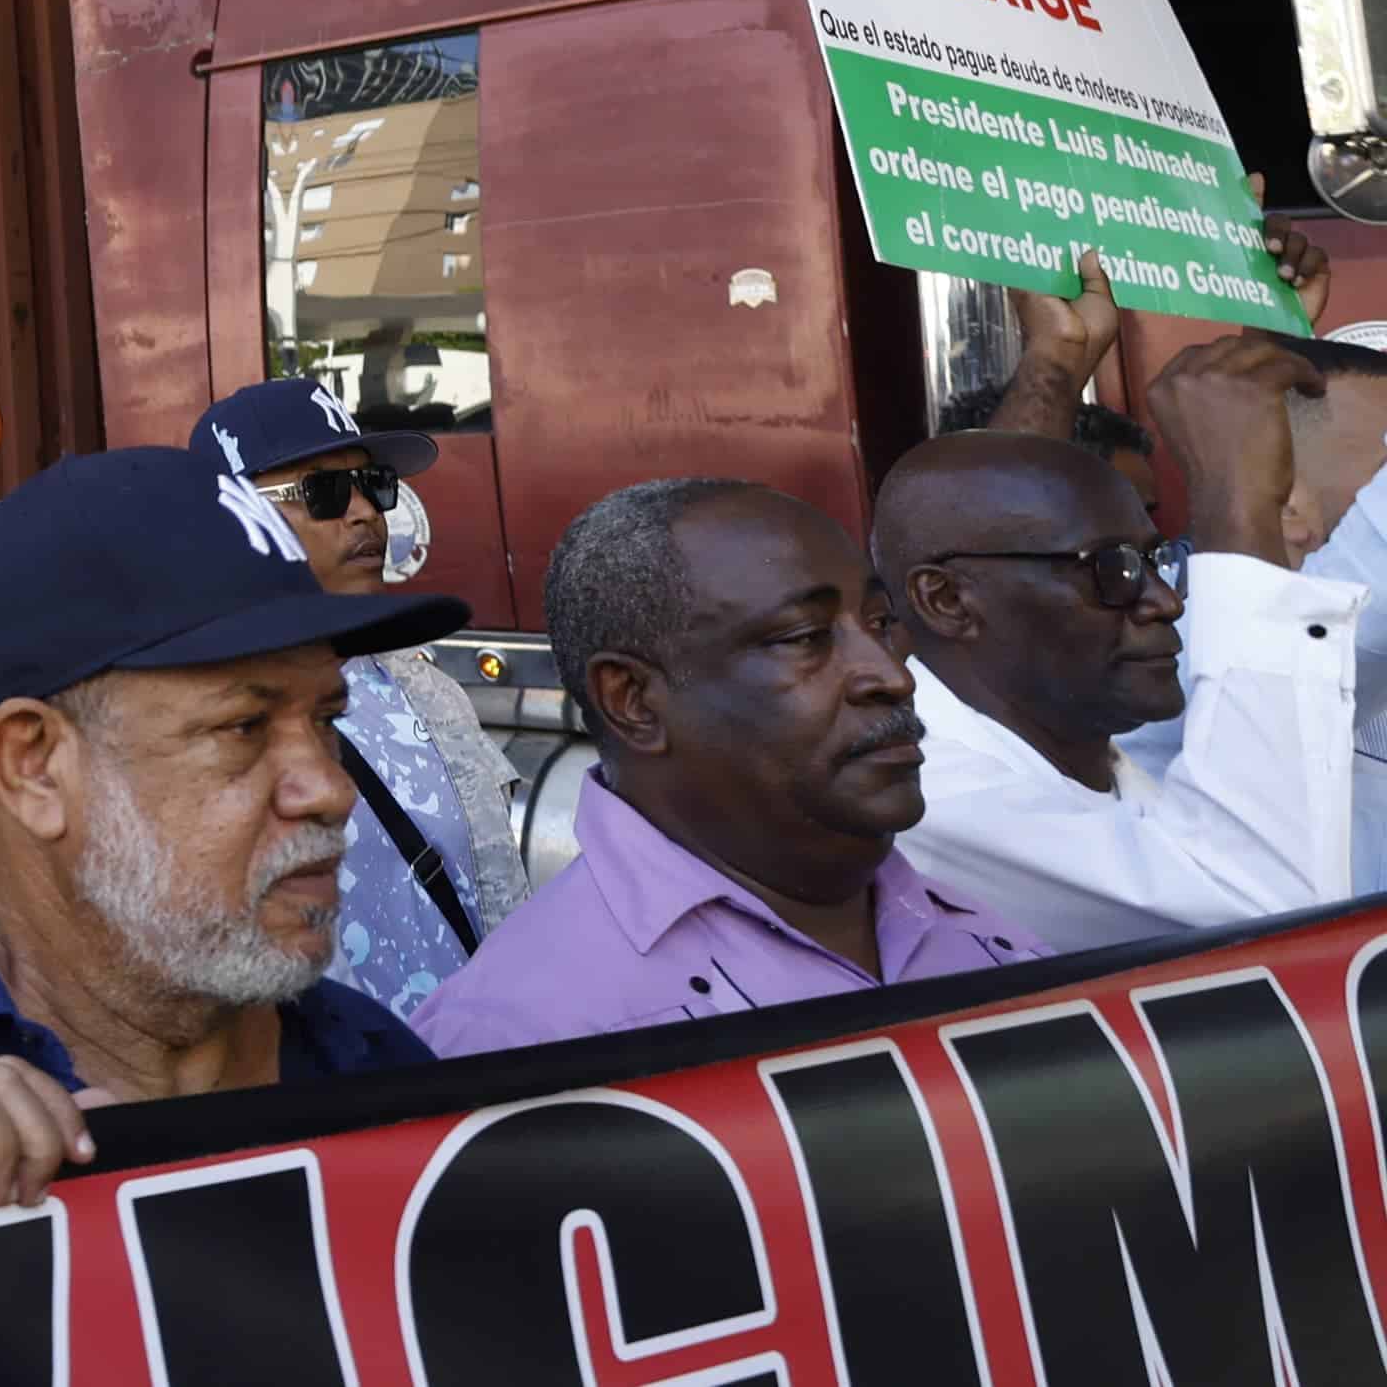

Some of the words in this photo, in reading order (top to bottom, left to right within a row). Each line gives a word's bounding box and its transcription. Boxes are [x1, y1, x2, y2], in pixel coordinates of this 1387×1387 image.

[820, 9, 859, 41] Que
[863, 19, 880, 46] el
[883, 29, 941, 62] estado
[946, 45, 997, 76] pague
[1001, 54, 1050, 87] deuda
[1053, 68, 1072, 92] de
[1076, 73, 1138, 109] choferes
[1139, 94, 1150, 118] y
[887, 81, 1045, 148] Presidente
[1049, 118, 1108, 161] Luis
[1113, 134, 1219, 188] Abinader
[869, 146, 974, 193] ordene
[982, 166, 1009, 199] el
[1016, 177, 1084, 220] pago
[1091, 192, 1220, 240] pendiente
[1225, 221, 1267, 252] con
[906, 211, 935, 246] el
[942, 223, 1063, 270] corredor
[1186, 260, 1275, 307] Gómez
